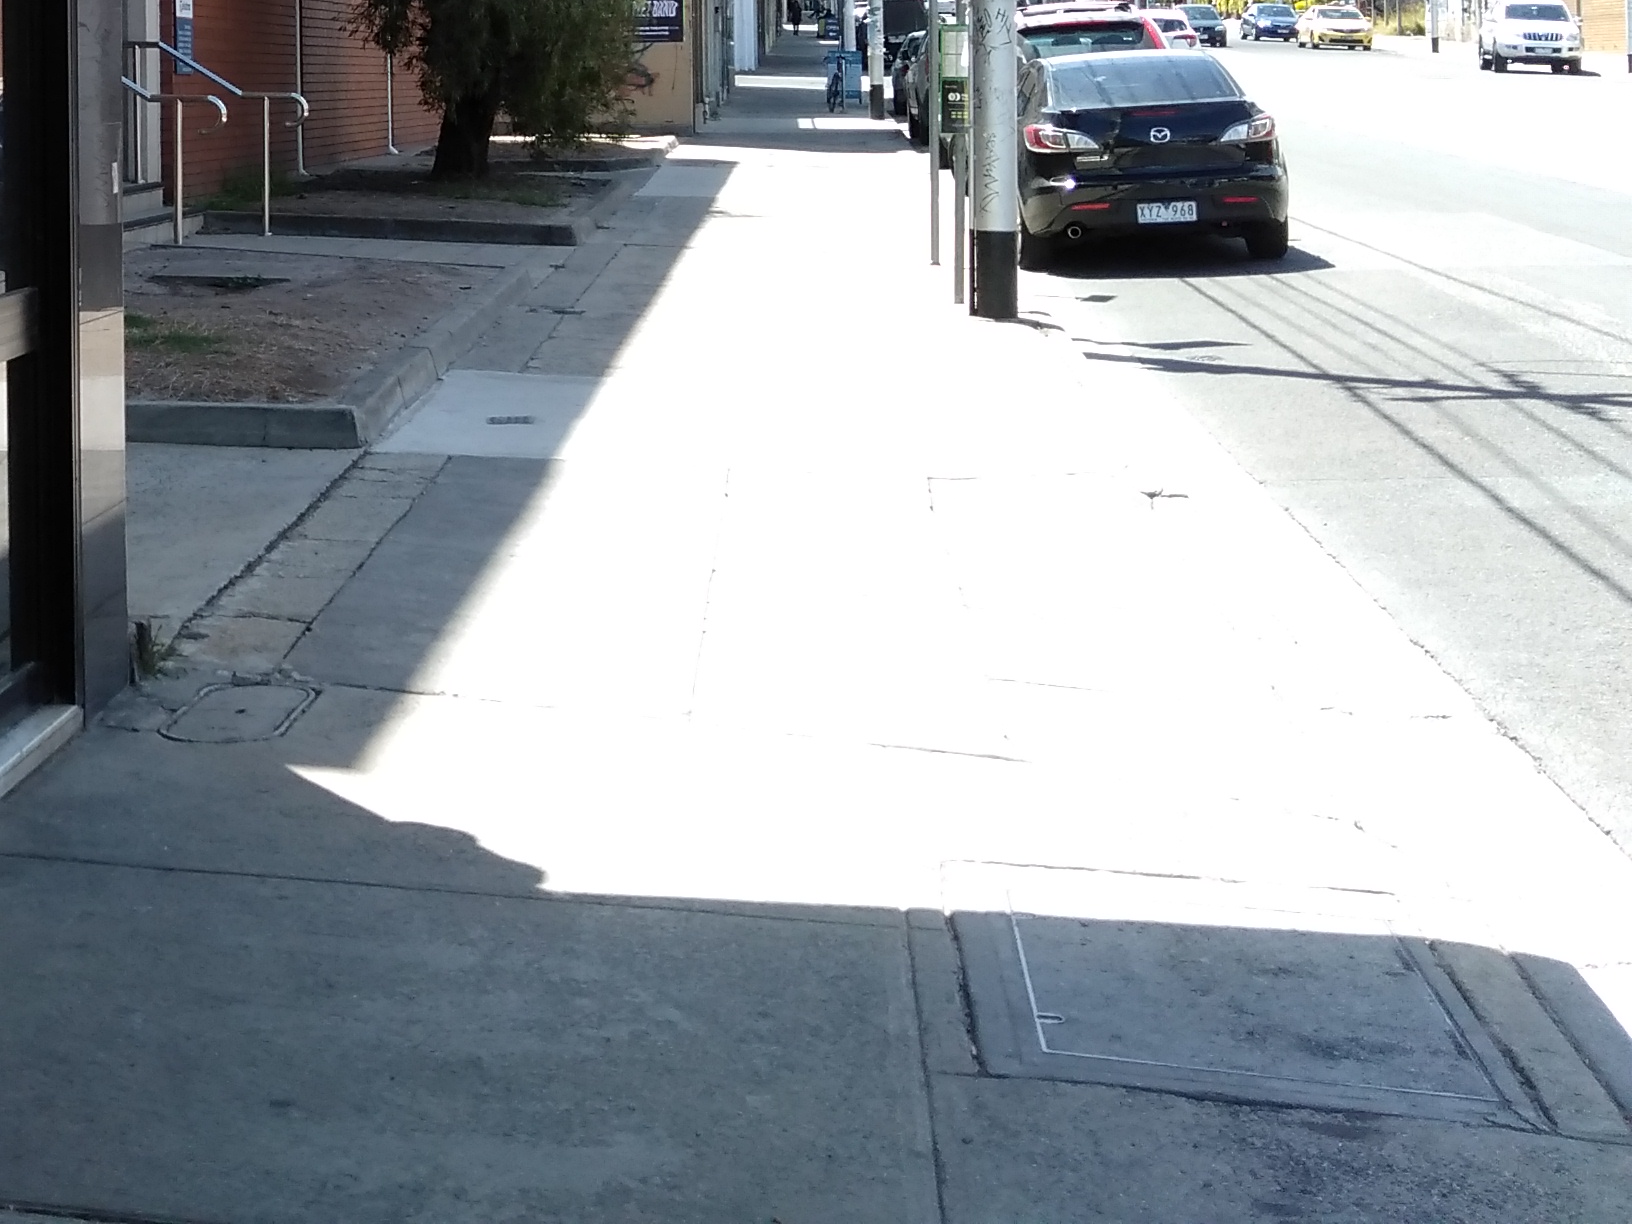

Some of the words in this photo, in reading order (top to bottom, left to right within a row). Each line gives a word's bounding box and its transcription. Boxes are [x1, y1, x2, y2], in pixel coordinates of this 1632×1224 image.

[652, 0, 679, 17] BAND
[1138, 204, 1162, 218] XYZ
[1171, 203, 1194, 217] 968
